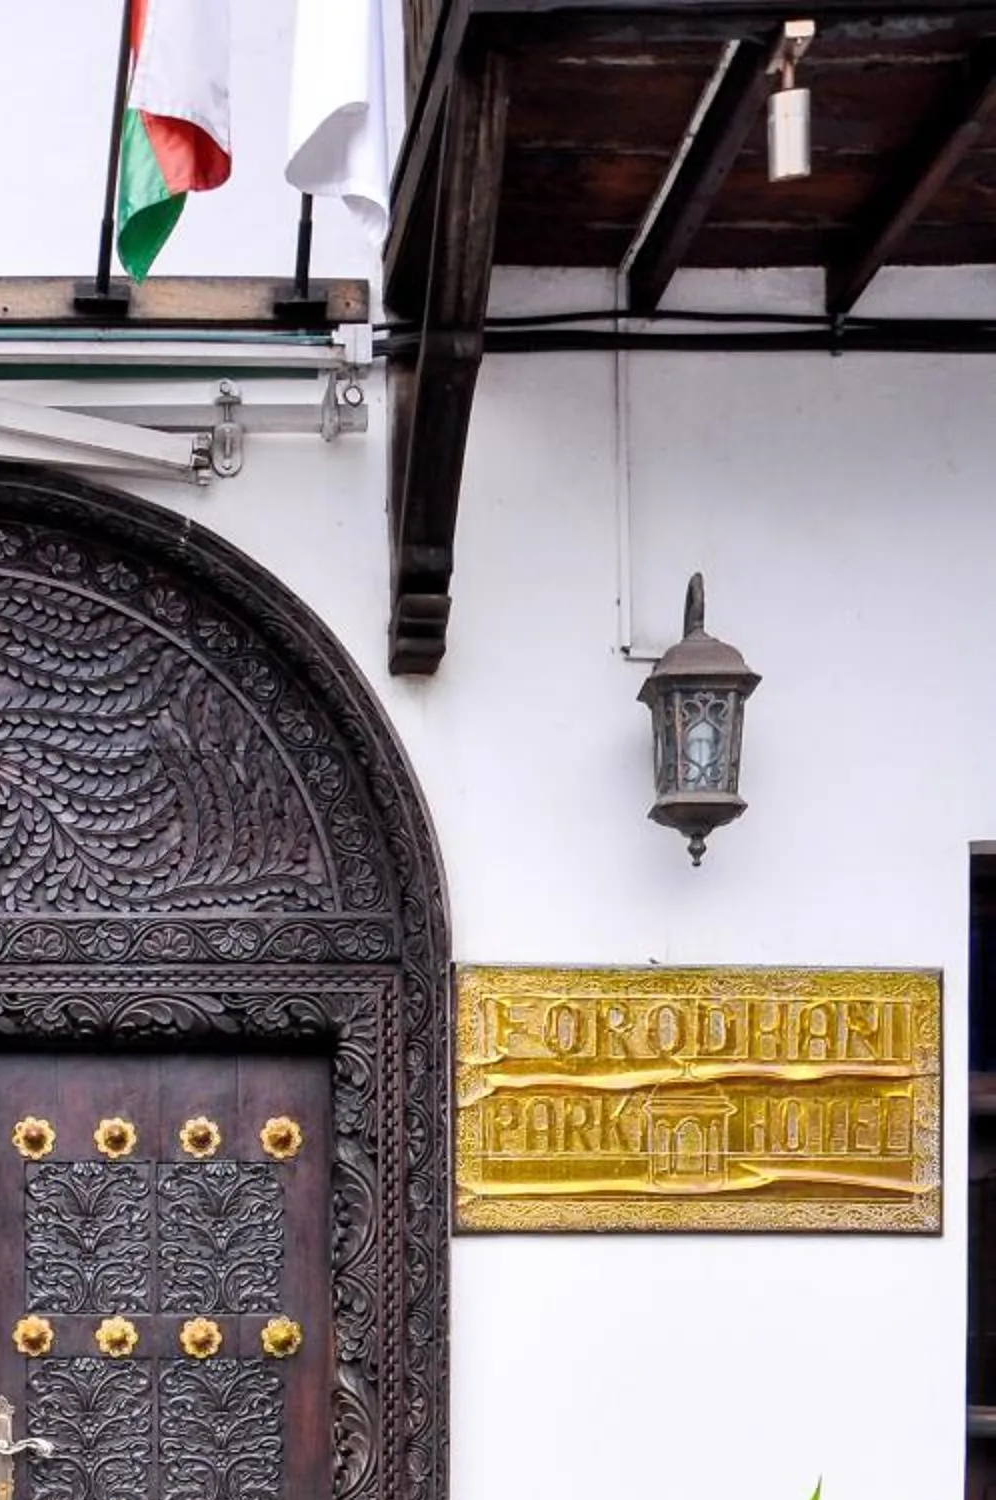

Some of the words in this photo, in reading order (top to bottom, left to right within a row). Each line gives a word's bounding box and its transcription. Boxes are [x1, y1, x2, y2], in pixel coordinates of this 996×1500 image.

[494, 998, 910, 1060] FORODHANI
[488, 1097, 632, 1152] PARK
[744, 1096, 911, 1152] HOTEL
